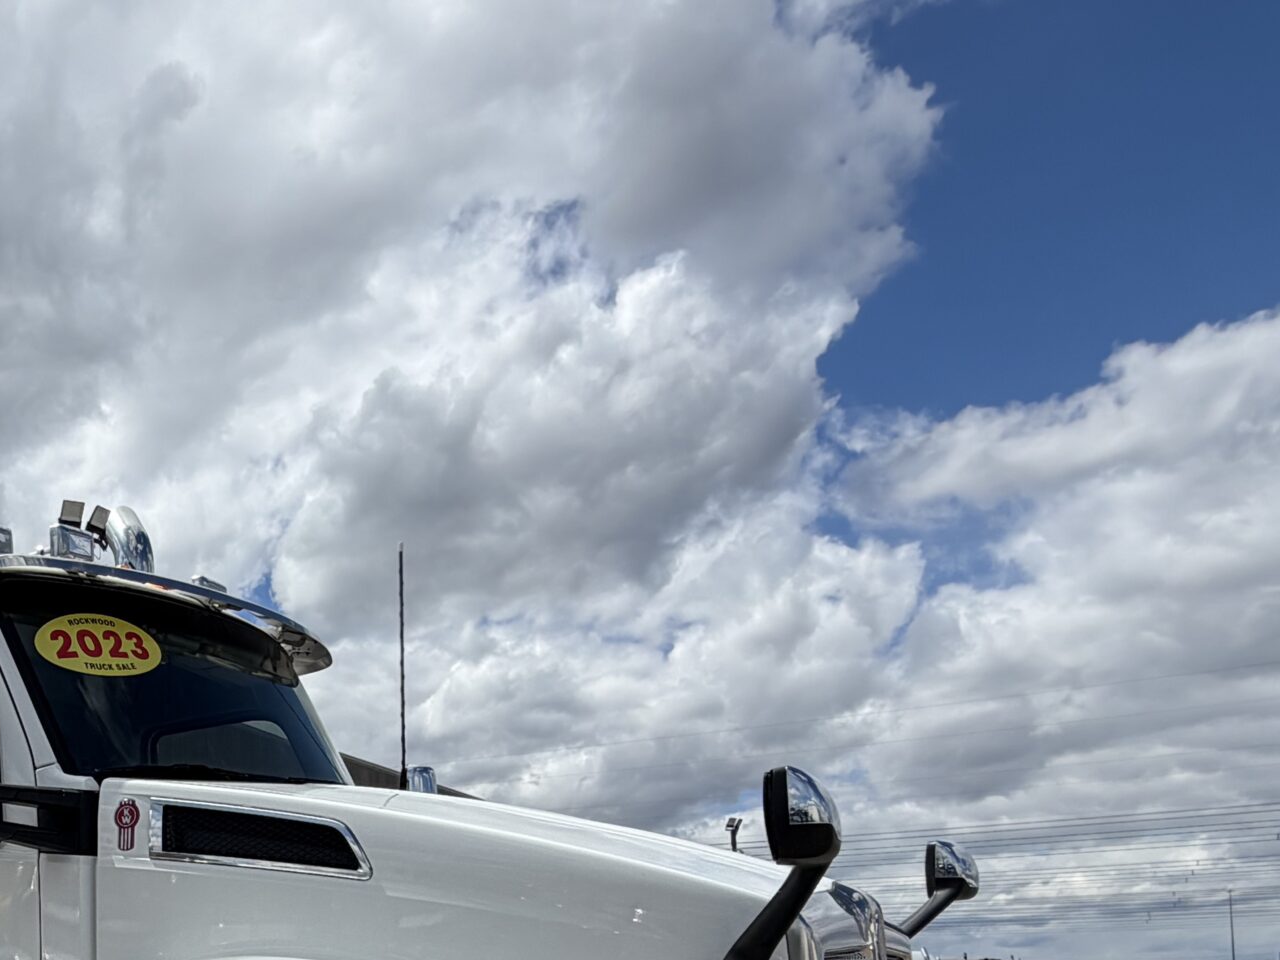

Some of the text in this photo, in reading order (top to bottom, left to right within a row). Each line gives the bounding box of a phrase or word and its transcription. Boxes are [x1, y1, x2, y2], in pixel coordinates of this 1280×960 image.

[67, 617, 116, 627] ROCKWOOD
[50, 629, 150, 660] 2023
[84, 662, 137, 671] TRUCK SALE
